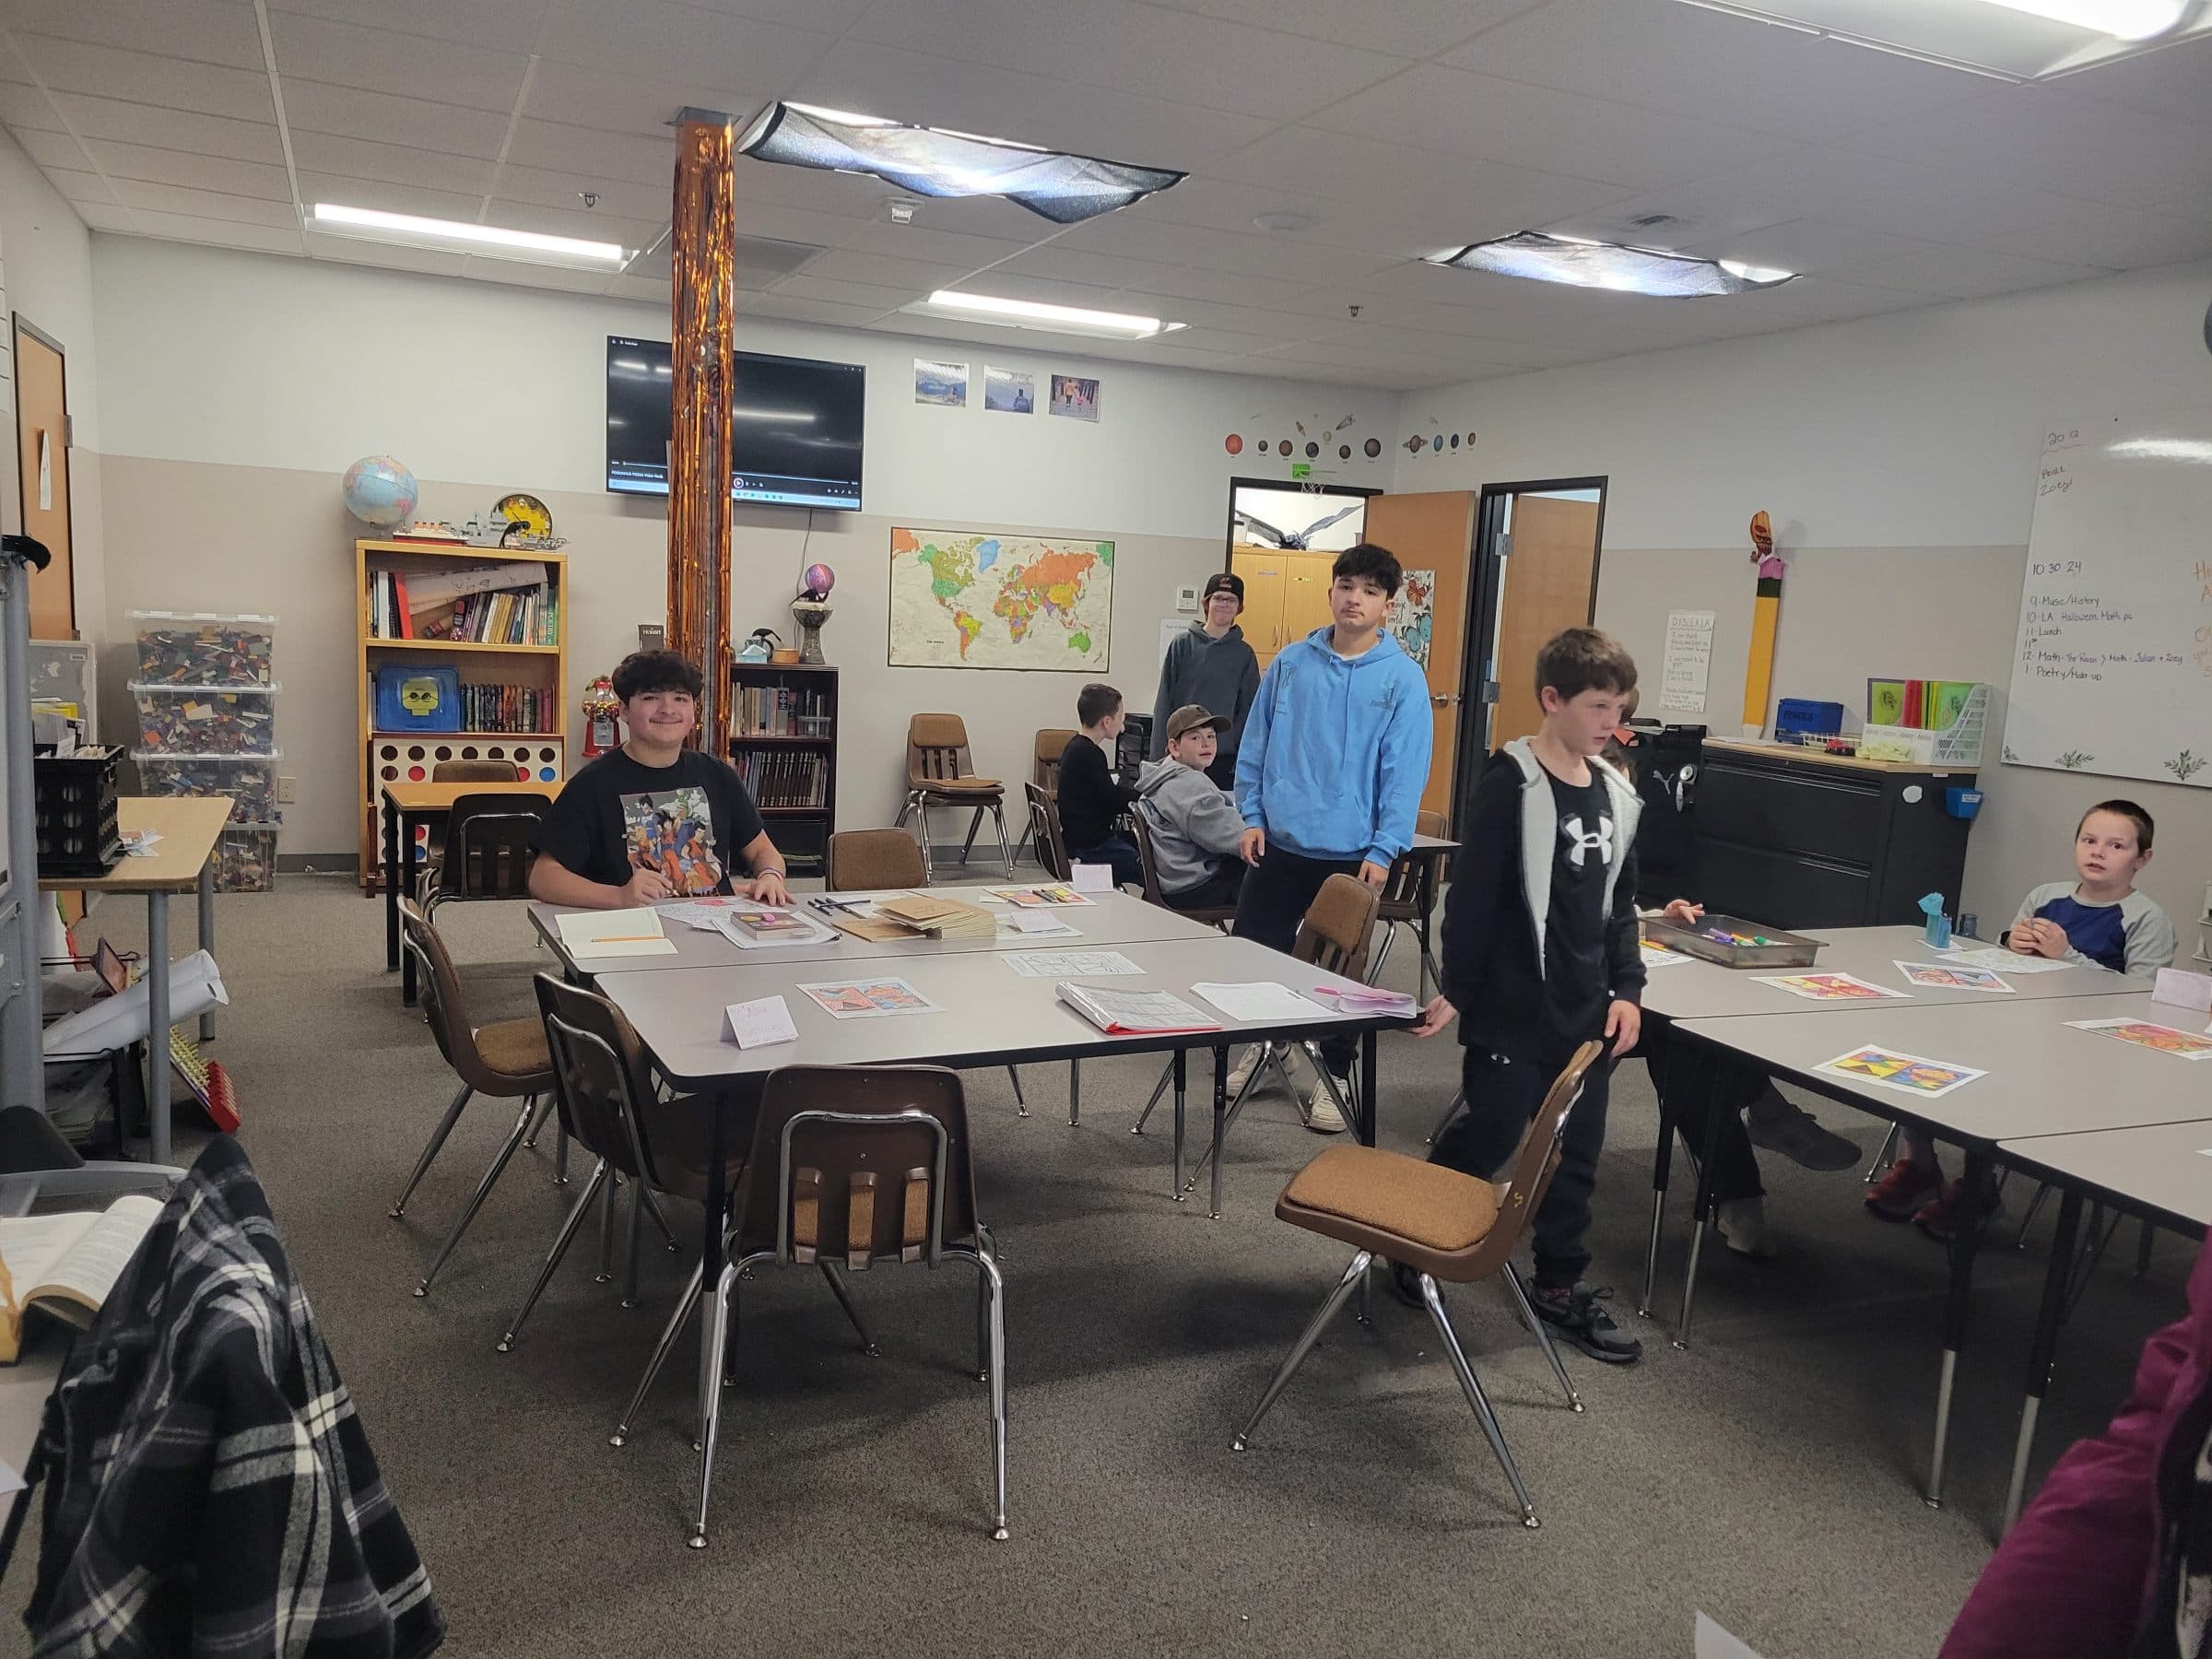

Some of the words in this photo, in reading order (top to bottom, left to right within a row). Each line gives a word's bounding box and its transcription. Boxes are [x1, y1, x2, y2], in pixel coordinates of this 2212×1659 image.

[2032, 563, 2044, 575] 10
[2048, 562, 2061, 574] 30
[2065, 560, 2082, 573] 24
[2039, 626, 2062, 636] Lunch
